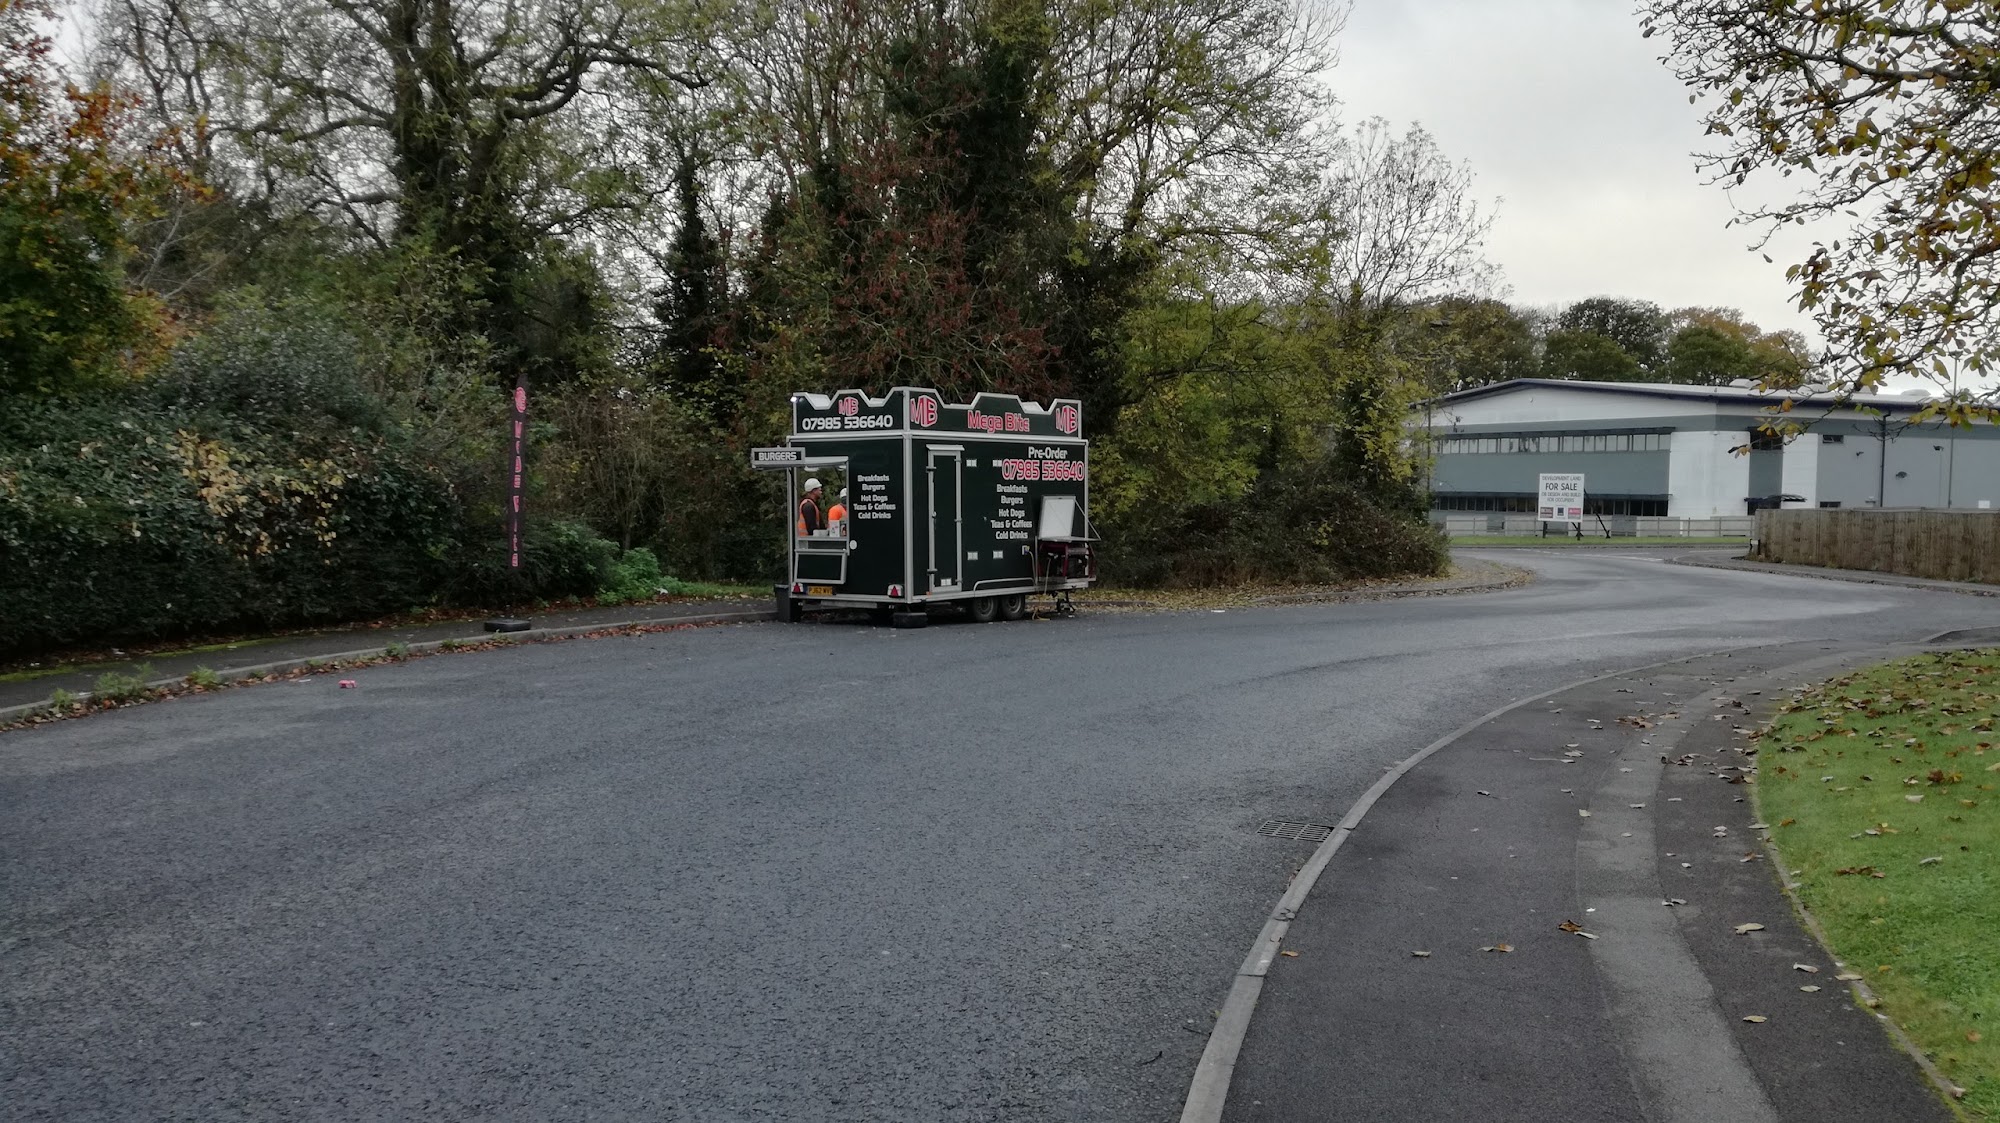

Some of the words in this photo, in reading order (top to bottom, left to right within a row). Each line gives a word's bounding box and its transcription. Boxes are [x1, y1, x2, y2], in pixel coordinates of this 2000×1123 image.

[911, 395, 937, 427] MB
[802, 417, 841, 430] 07985
[844, 415, 893, 429] 536640
[968, 410, 1002, 433] Mega
[1005, 412, 1030, 432] Bite
[1056, 405, 1078, 434] MB
[759, 452, 797, 461] BURGERS
[1028, 447, 1068, 459] Pre-Order
[1002, 459, 1040, 480] 07985
[1042, 460, 1084, 481] 536640
[857, 474, 890, 482] Breakfasts
[996, 484, 1028, 493] Breakfasts
[872, 494, 888, 502] Dogs
[1001, 496, 1024, 506] Burgers
[998, 508, 1009, 517] Hot
[1010, 509, 1025, 518] Dogs
[990, 520, 1004, 528] Teas
[1005, 520, 1010, 528] &
[1012, 520, 1032, 528] Coffees
[996, 531, 1008, 540] Cold
[1010, 531, 1028, 539] Drinks
